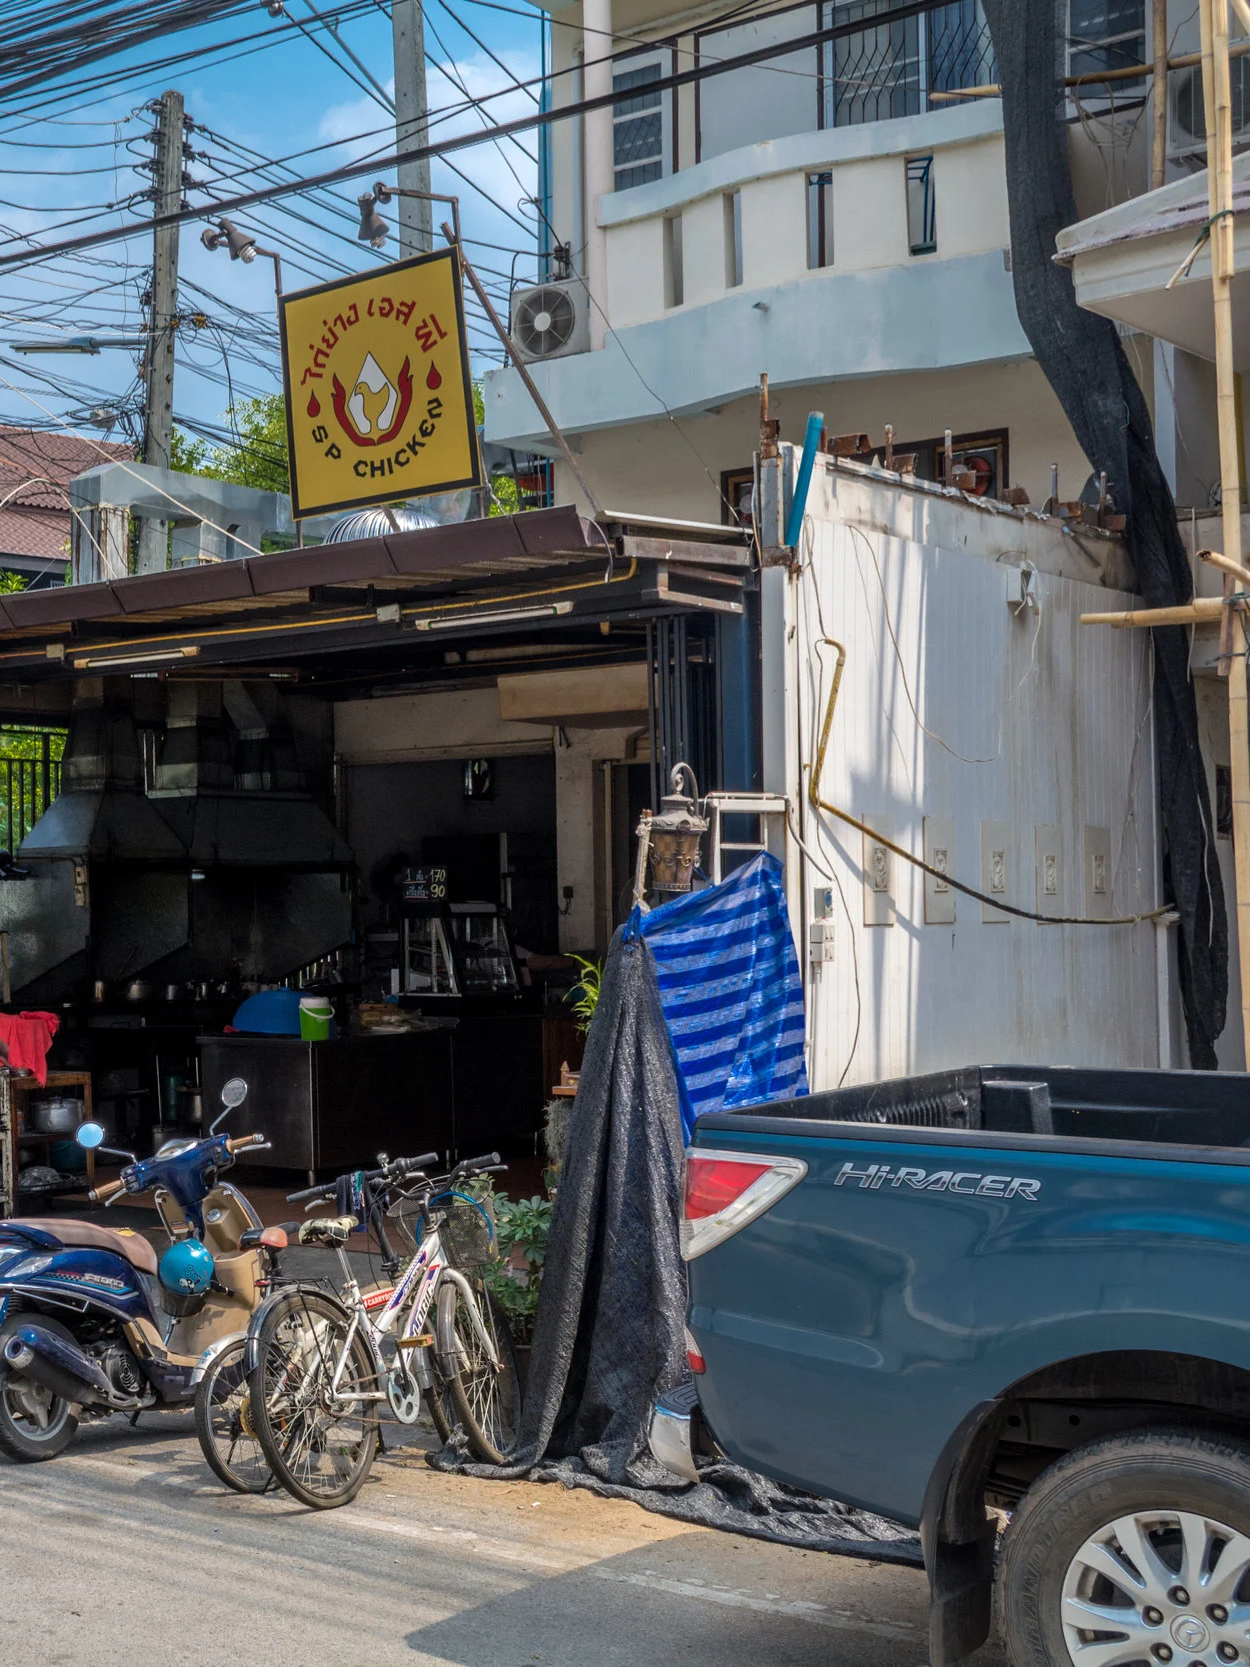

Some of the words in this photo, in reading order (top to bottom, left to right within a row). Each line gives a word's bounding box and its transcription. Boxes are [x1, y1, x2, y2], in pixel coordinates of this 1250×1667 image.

[301, 302, 360, 386] ไก่ย่าง
[367, 297, 416, 326] เอส
[414, 314, 448, 353] พี
[311, 425, 342, 460] SP
[353, 397, 443, 478] CHICKEN
[430, 868, 446, 882] 170
[430, 883, 446, 898] 90
[833, 1162, 1042, 1201] Hi-RACER
